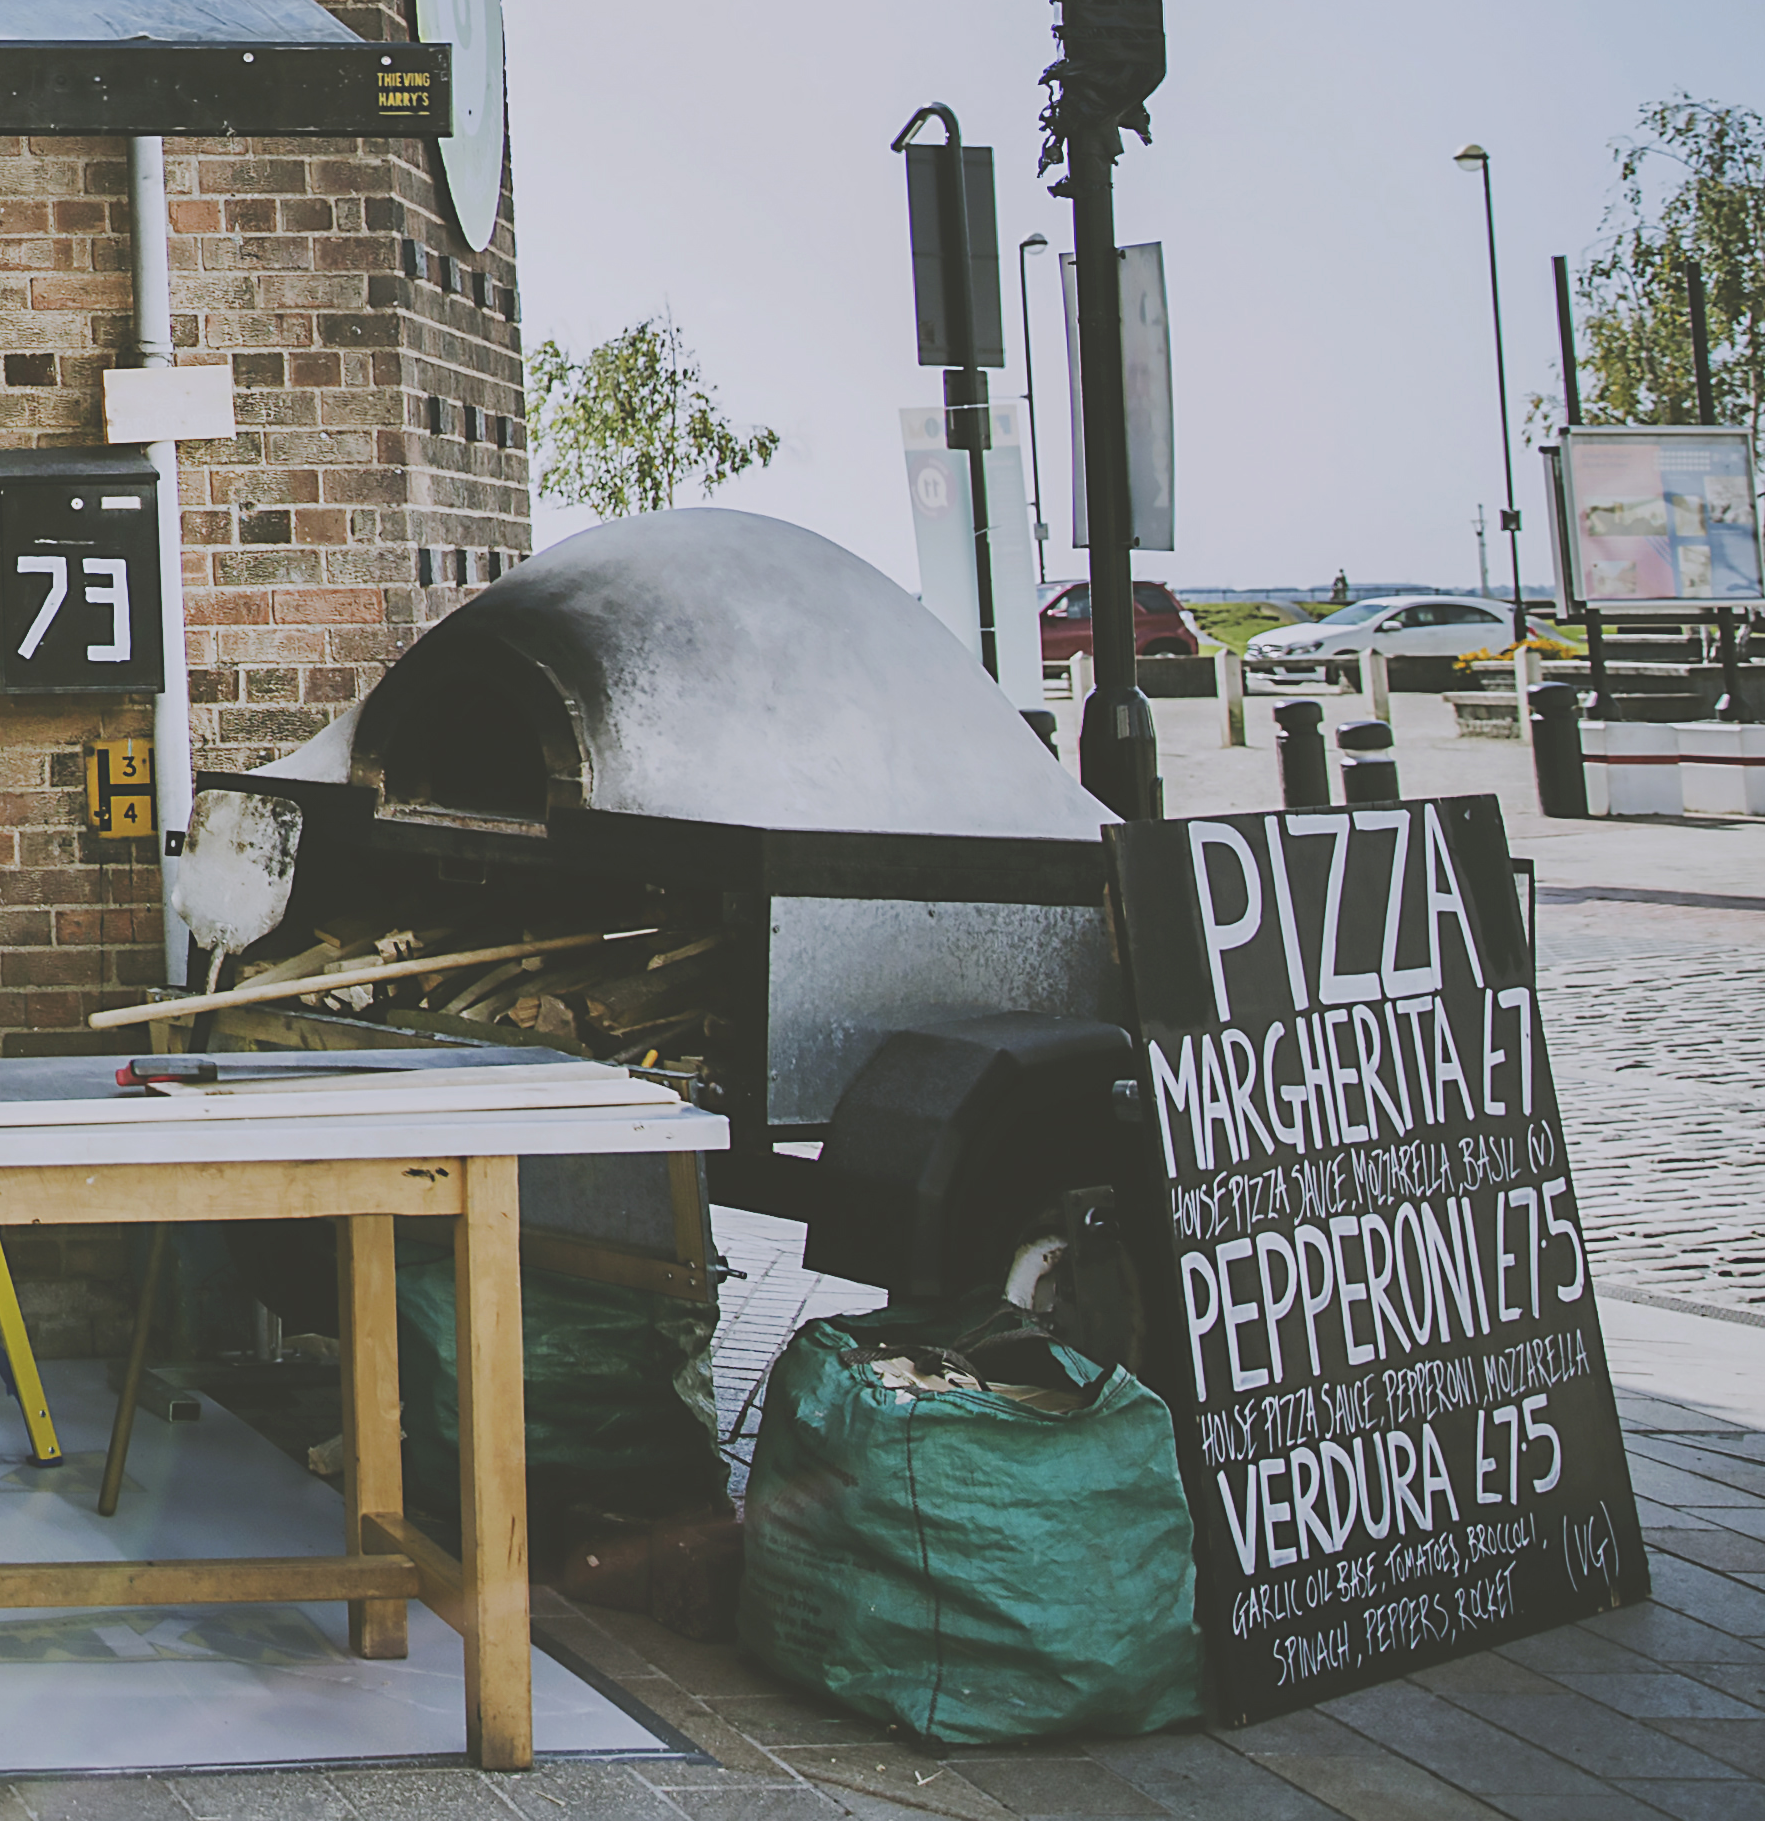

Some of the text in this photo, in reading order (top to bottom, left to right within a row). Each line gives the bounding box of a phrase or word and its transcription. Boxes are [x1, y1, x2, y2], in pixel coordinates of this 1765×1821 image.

[376, 71, 431, 88] THIEVING
[377, 92, 430, 108] HARRY'S
[16, 555, 130, 663] 73
[120, 756, 137, 778] 3
[122, 802, 139, 825] 4
[1188, 803, 1484, 1023] PIZZA
[1148, 995, 1474, 1178] MARGHERITA
[1171, 1171, 1229, 1240] HOUSE
[1229, 1165, 1290, 1233] PIZZA
[1458, 1135, 1522, 1191] BASIL
[1181, 1193, 1490, 1403] PEPPERONI
[1201, 1399, 1257, 1466] HOUSE
[1261, 1386, 1319, 1453] PIZZA
[1484, 1328, 1591, 1404] MOZZARELLA
[1217, 1423, 1460, 1575] VERDURA
[1233, 1578, 1303, 1639] GARLIC
[1305, 1567, 1333, 1608] OIL
[1563, 1500, 1620, 1592] (VG)
[1455, 1561, 1517, 1631] ROCKET
